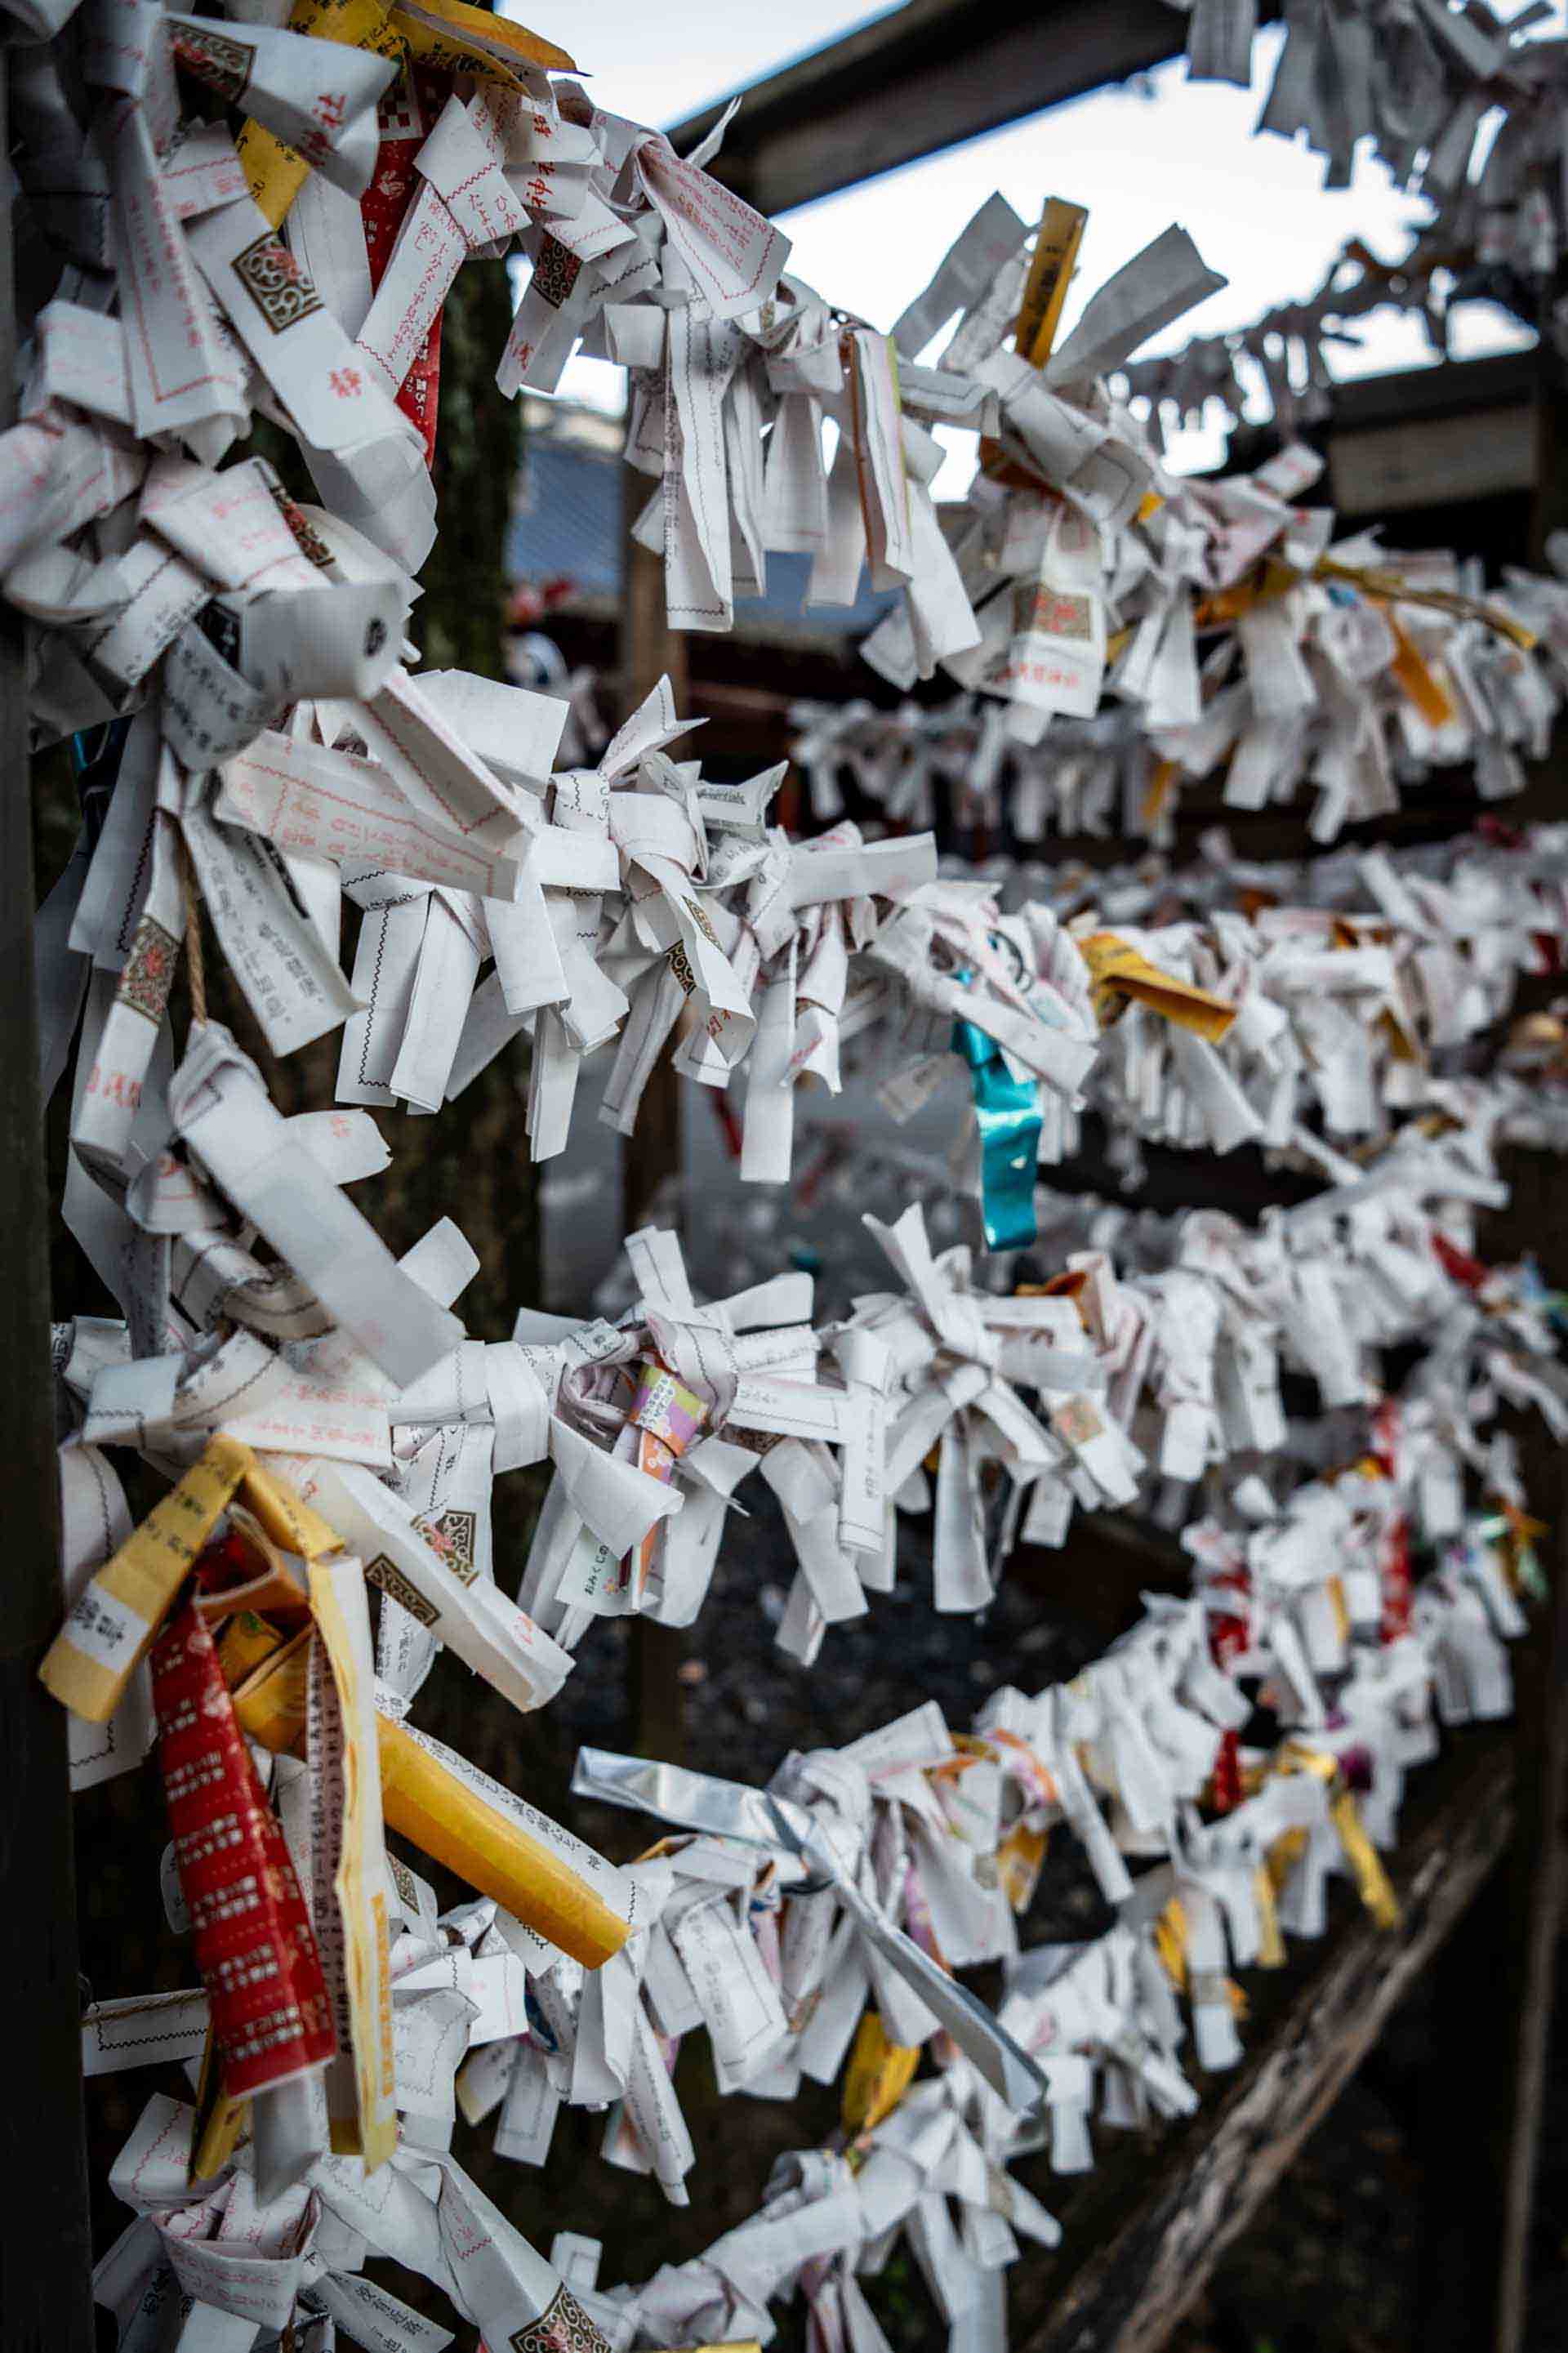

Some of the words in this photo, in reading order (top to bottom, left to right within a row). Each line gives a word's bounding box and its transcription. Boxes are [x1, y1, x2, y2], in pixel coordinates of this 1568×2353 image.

[584, 1544, 611, 1596] おみくじの
